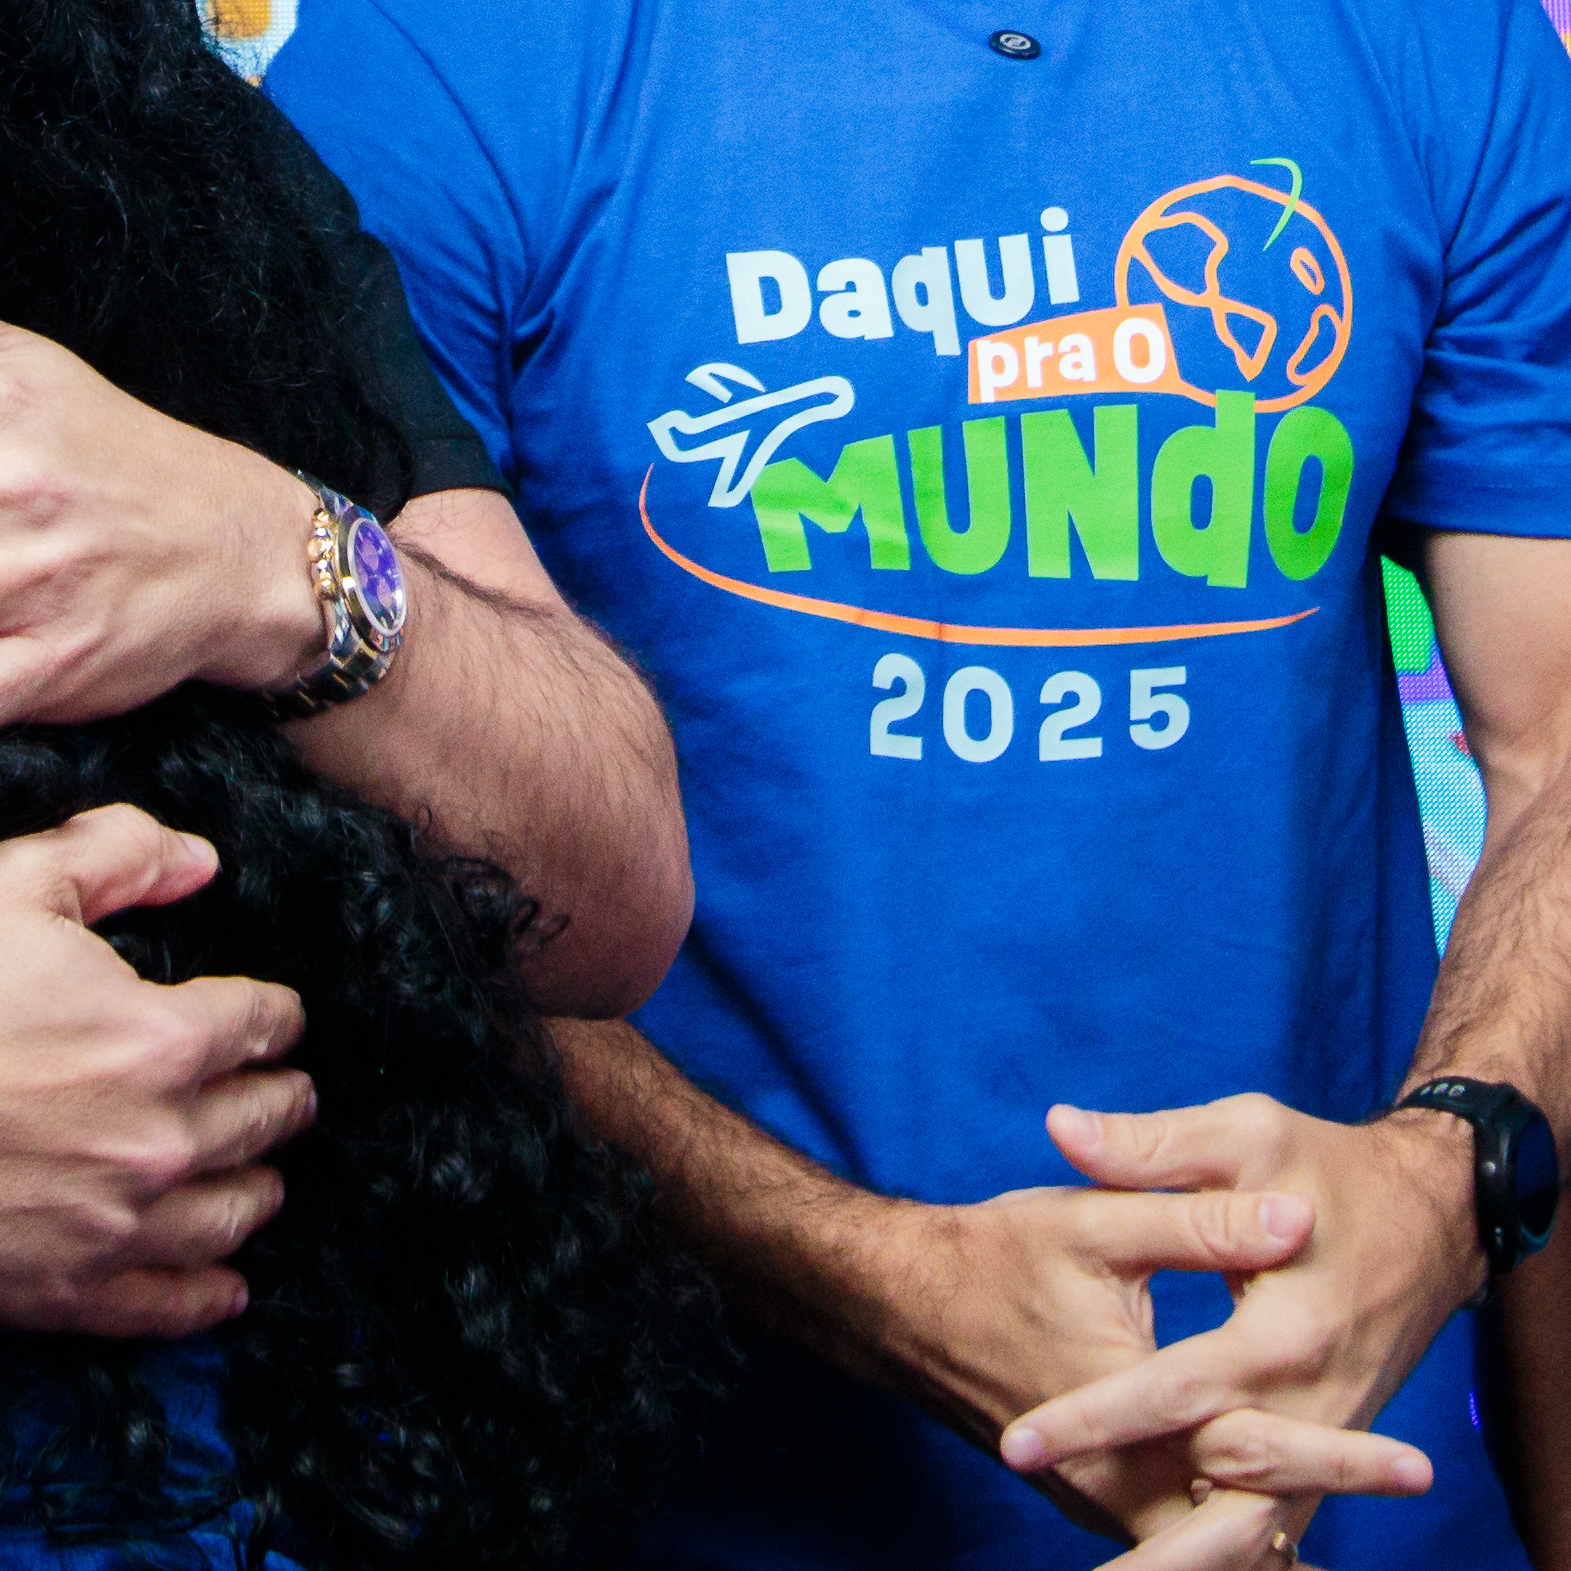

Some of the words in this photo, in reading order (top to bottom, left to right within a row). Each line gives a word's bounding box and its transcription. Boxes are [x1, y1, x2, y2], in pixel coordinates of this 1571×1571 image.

[725, 206, 1080, 356] Daqui
[977, 330, 1097, 404] pra
[869, 652, 1191, 764] 2025
